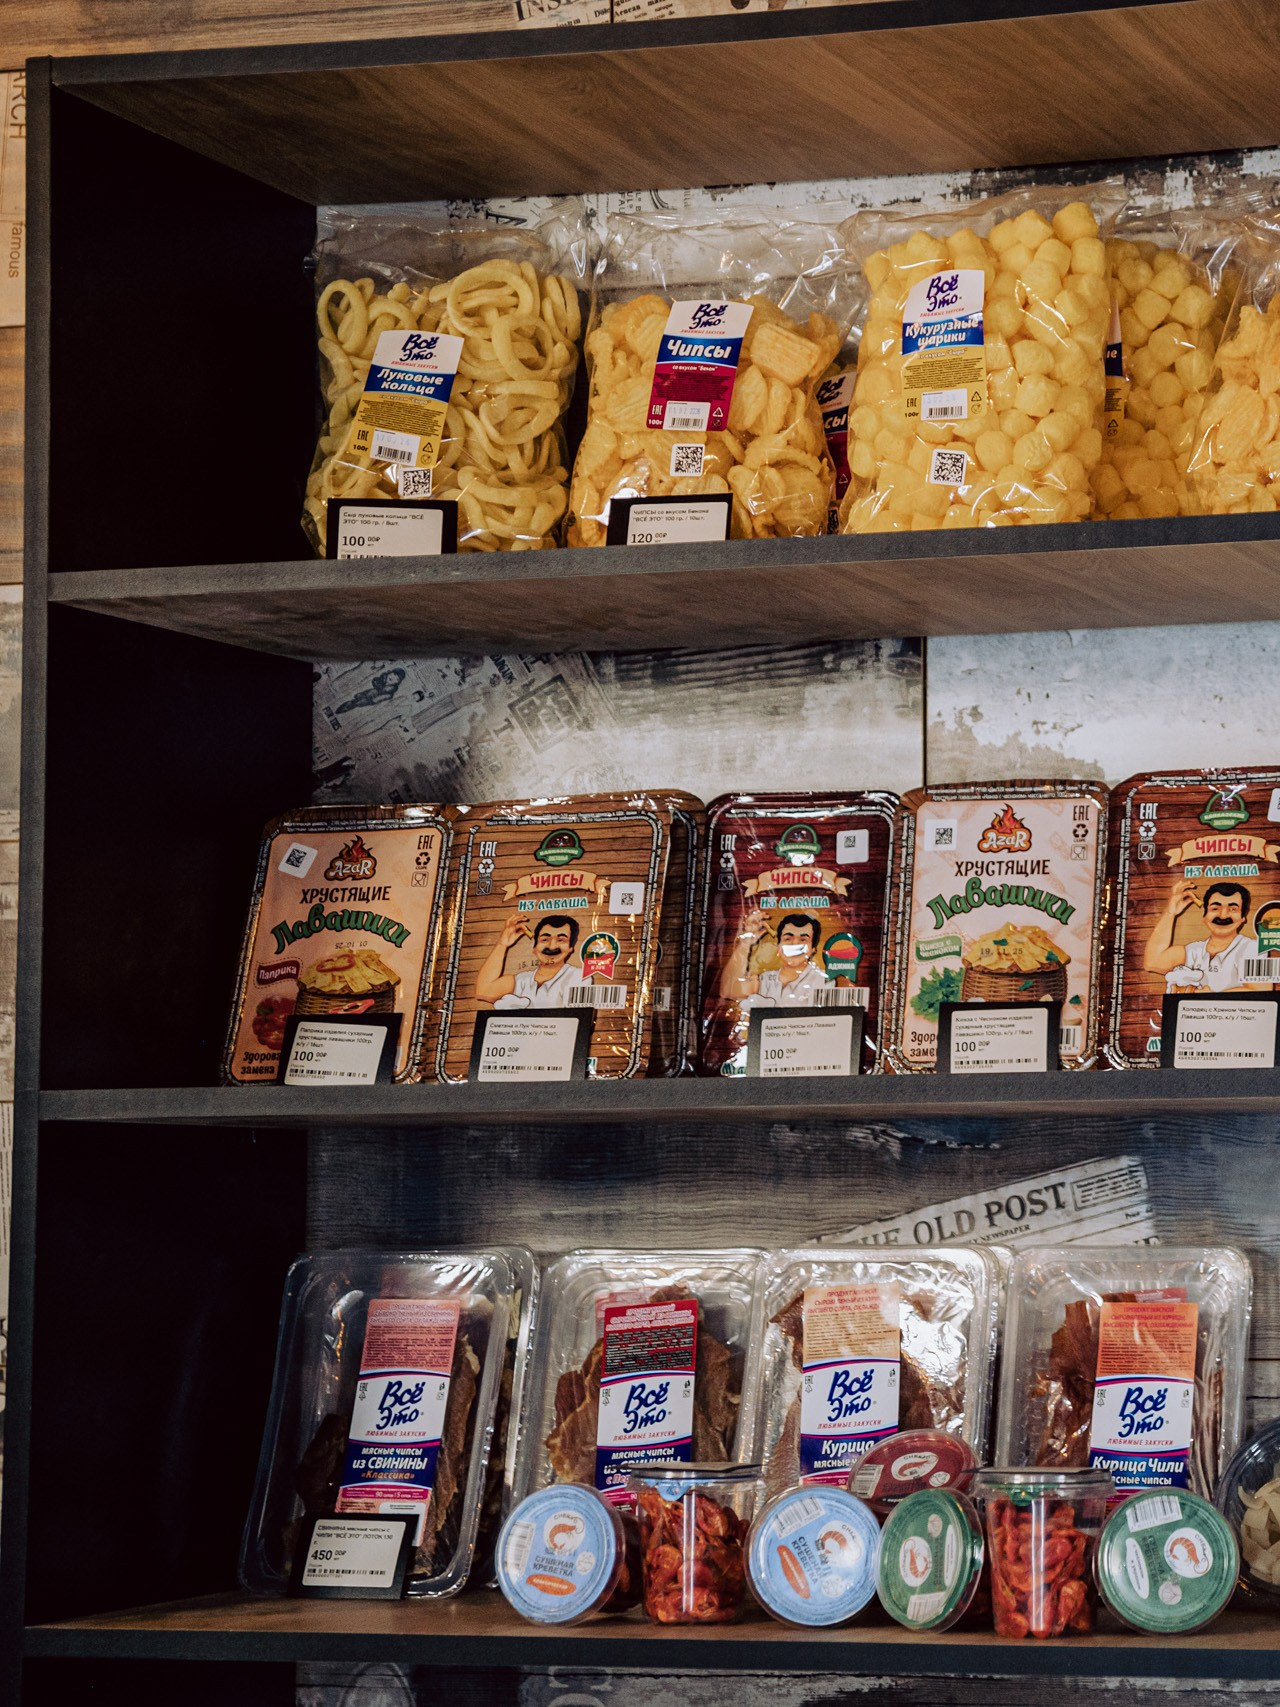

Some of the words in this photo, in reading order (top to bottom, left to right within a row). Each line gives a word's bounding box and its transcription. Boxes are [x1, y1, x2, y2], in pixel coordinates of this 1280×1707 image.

[927, 274, 959, 299] Всё
[927, 294, 958, 312] Это
[905, 318, 979, 337] Кукурузные
[402, 334, 439, 350] Всё
[918, 332, 966, 347] шарики
[400, 349, 433, 361] Это
[667, 339, 731, 358] Чипсы
[378, 368, 444, 385] Луковые
[381, 381, 435, 395] кольца
[342, 536, 365, 546] 100
[631, 534, 652, 543] 120
[984, 832, 1030, 848] AzaR
[1196, 838, 1252, 853] ЧИПСЫ
[329, 859, 374, 876] AzaR
[955, 860, 1051, 877] ХРУСТЯЩИЕ
[1205, 864, 1259, 877] ЛАВАША
[530, 873, 584, 889] ЧИПСЫ
[771, 871, 823, 884] ЧИПСЫ
[300, 885, 392, 904] ХРУСТЯЩИЕ
[537, 898, 588, 910] ЛАВАША
[926, 877, 1077, 929] Лавашики
[271, 903, 412, 955] Лавашики
[259, 964, 297, 980] Паприка
[1180, 1032, 1201, 1042] 100
[485, 1047, 505, 1057] 100
[764, 1050, 783, 1059] 100
[955, 1042, 976, 1052] 100
[292, 1051, 314, 1062] 100
[241, 1064, 275, 1075] замена
[913, 1209, 976, 1245] OLD
[984, 1182, 1067, 1228] POST
[827, 1369, 874, 1402] Всё
[378, 1380, 426, 1413] Всё
[624, 1382, 670, 1417] Всё
[1119, 1387, 1168, 1417] Всё
[827, 1396, 871, 1422] Это
[375, 1406, 420, 1430] Это
[623, 1408, 667, 1433] Это
[817, 1421, 851, 1429] ЛЮБИМЫЕ
[853, 1419, 882, 1427] ЗАКУСКИ
[1118, 1413, 1164, 1438] Это
[1107, 1438, 1143, 1446] ЛЮБИМЫЕ
[352, 1460, 366, 1468] из
[368, 1457, 428, 1469] СВИНИНЫ
[1093, 1456, 1147, 1477] Курица
[1148, 1458, 1184, 1473] Чили
[362, 1470, 415, 1479] «Классика»
[1141, 1477, 1172, 1486] чипсы
[311, 1550, 333, 1560] 450
